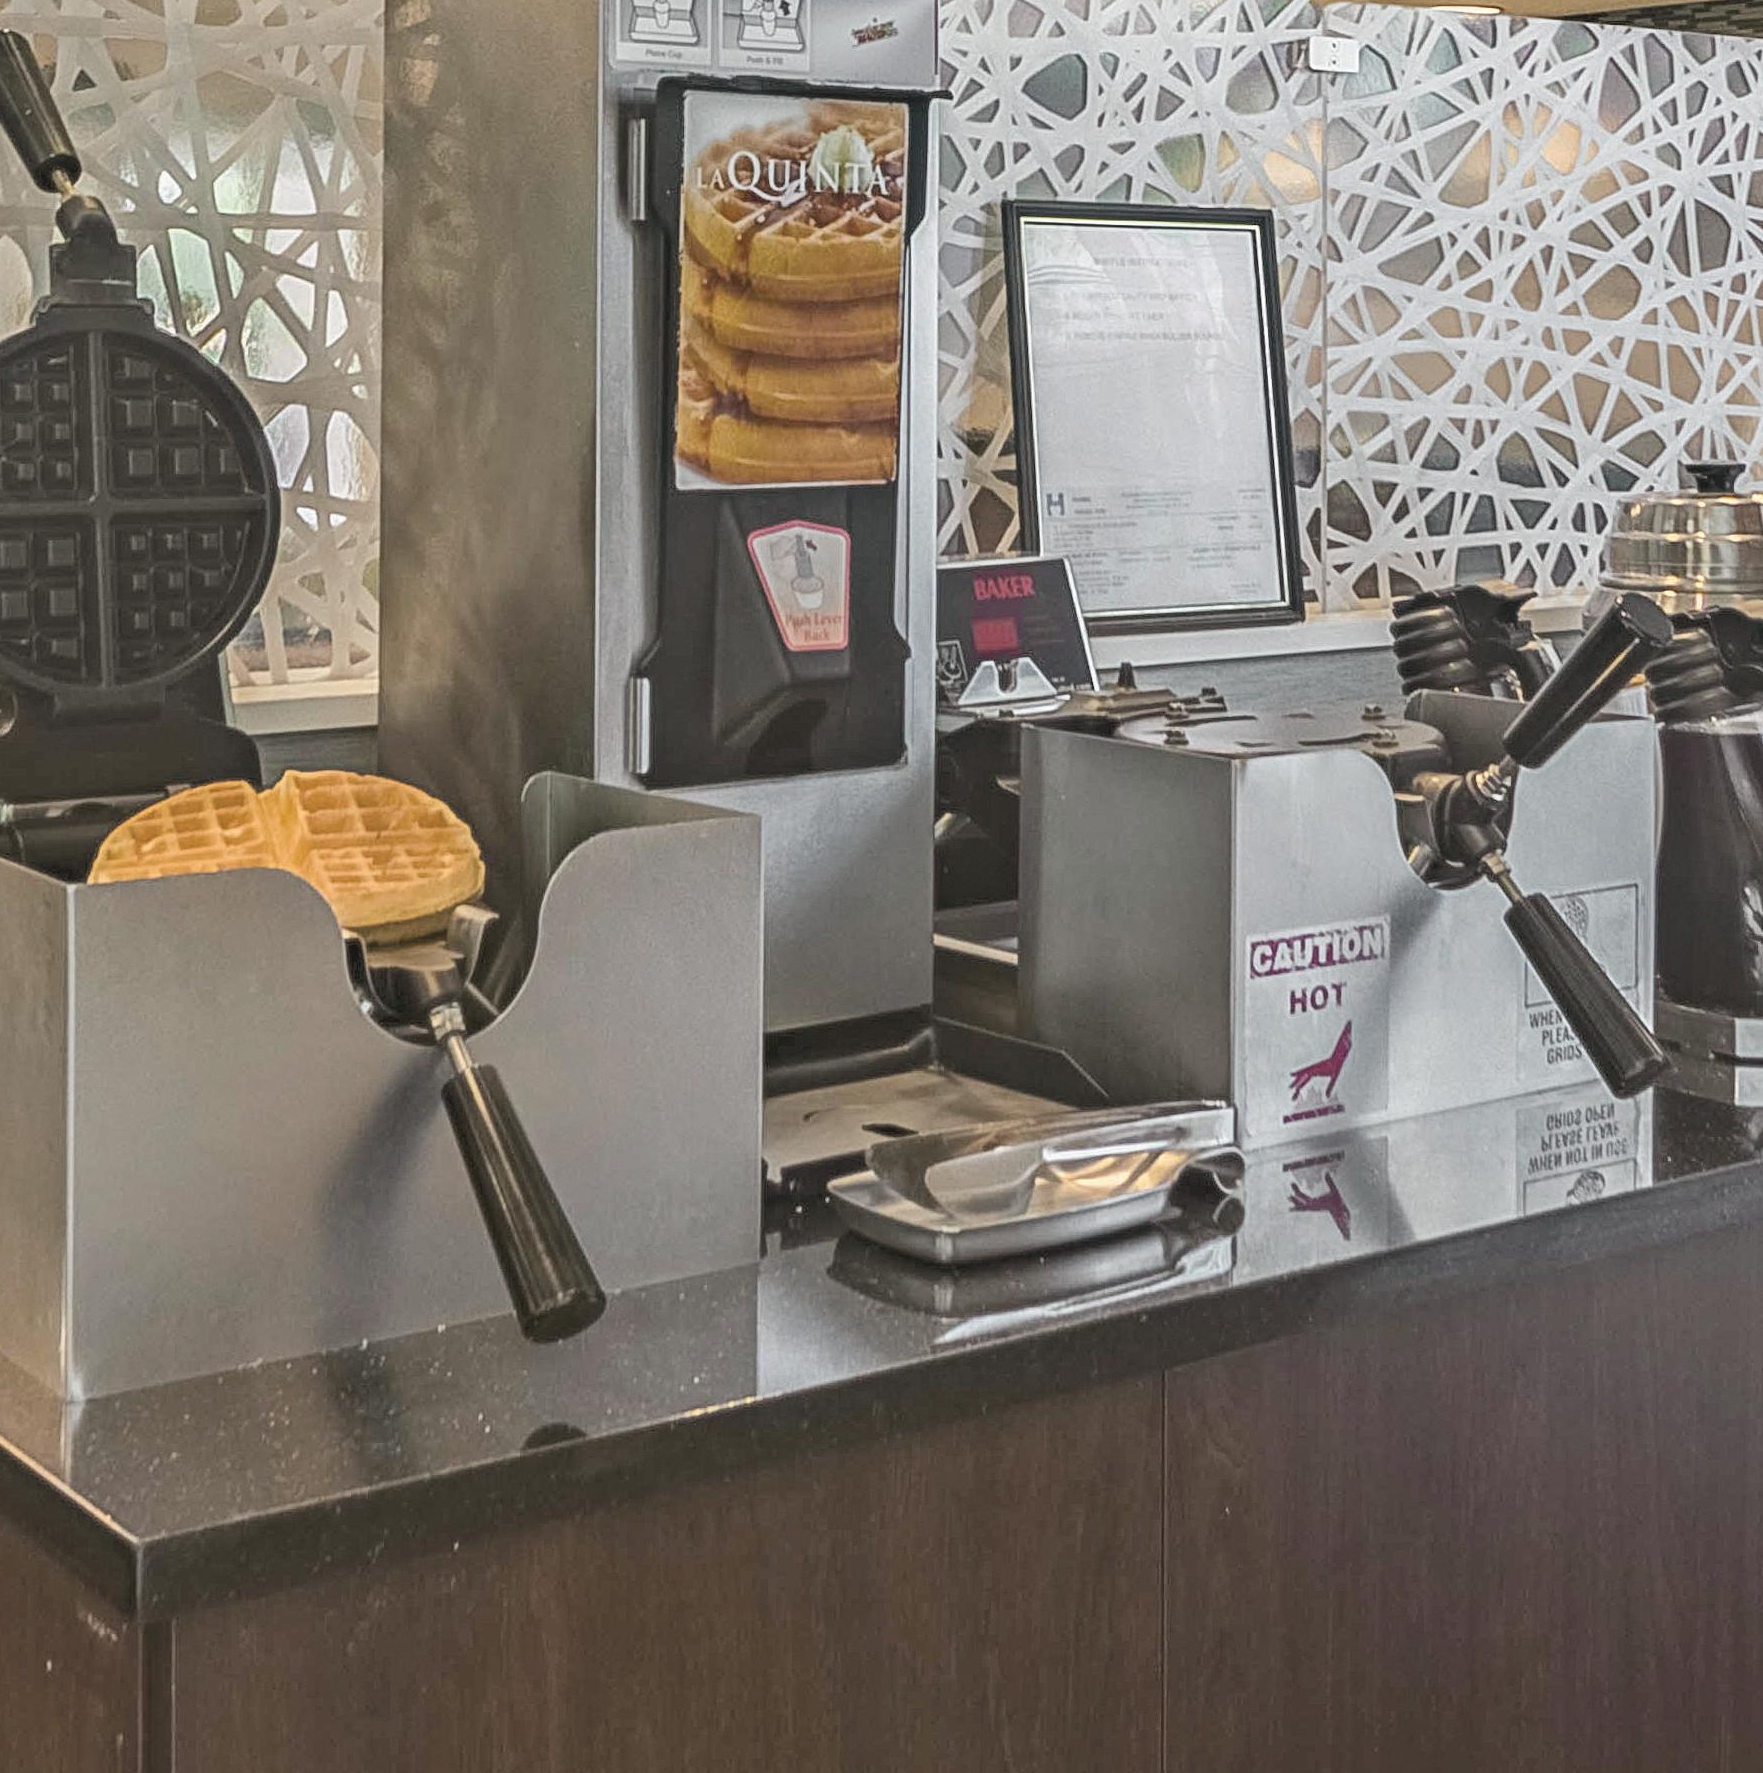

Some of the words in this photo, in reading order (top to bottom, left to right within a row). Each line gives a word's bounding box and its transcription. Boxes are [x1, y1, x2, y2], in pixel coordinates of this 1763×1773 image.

[695, 165, 726, 190] LA
[727, 150, 889, 202] QUINTA
[973, 574, 1035, 602] BAKER
[1251, 927, 1382, 974] CAUTION
[1290, 982, 1347, 1014] HOT
[1546, 1044, 1583, 1065] GRIDS
